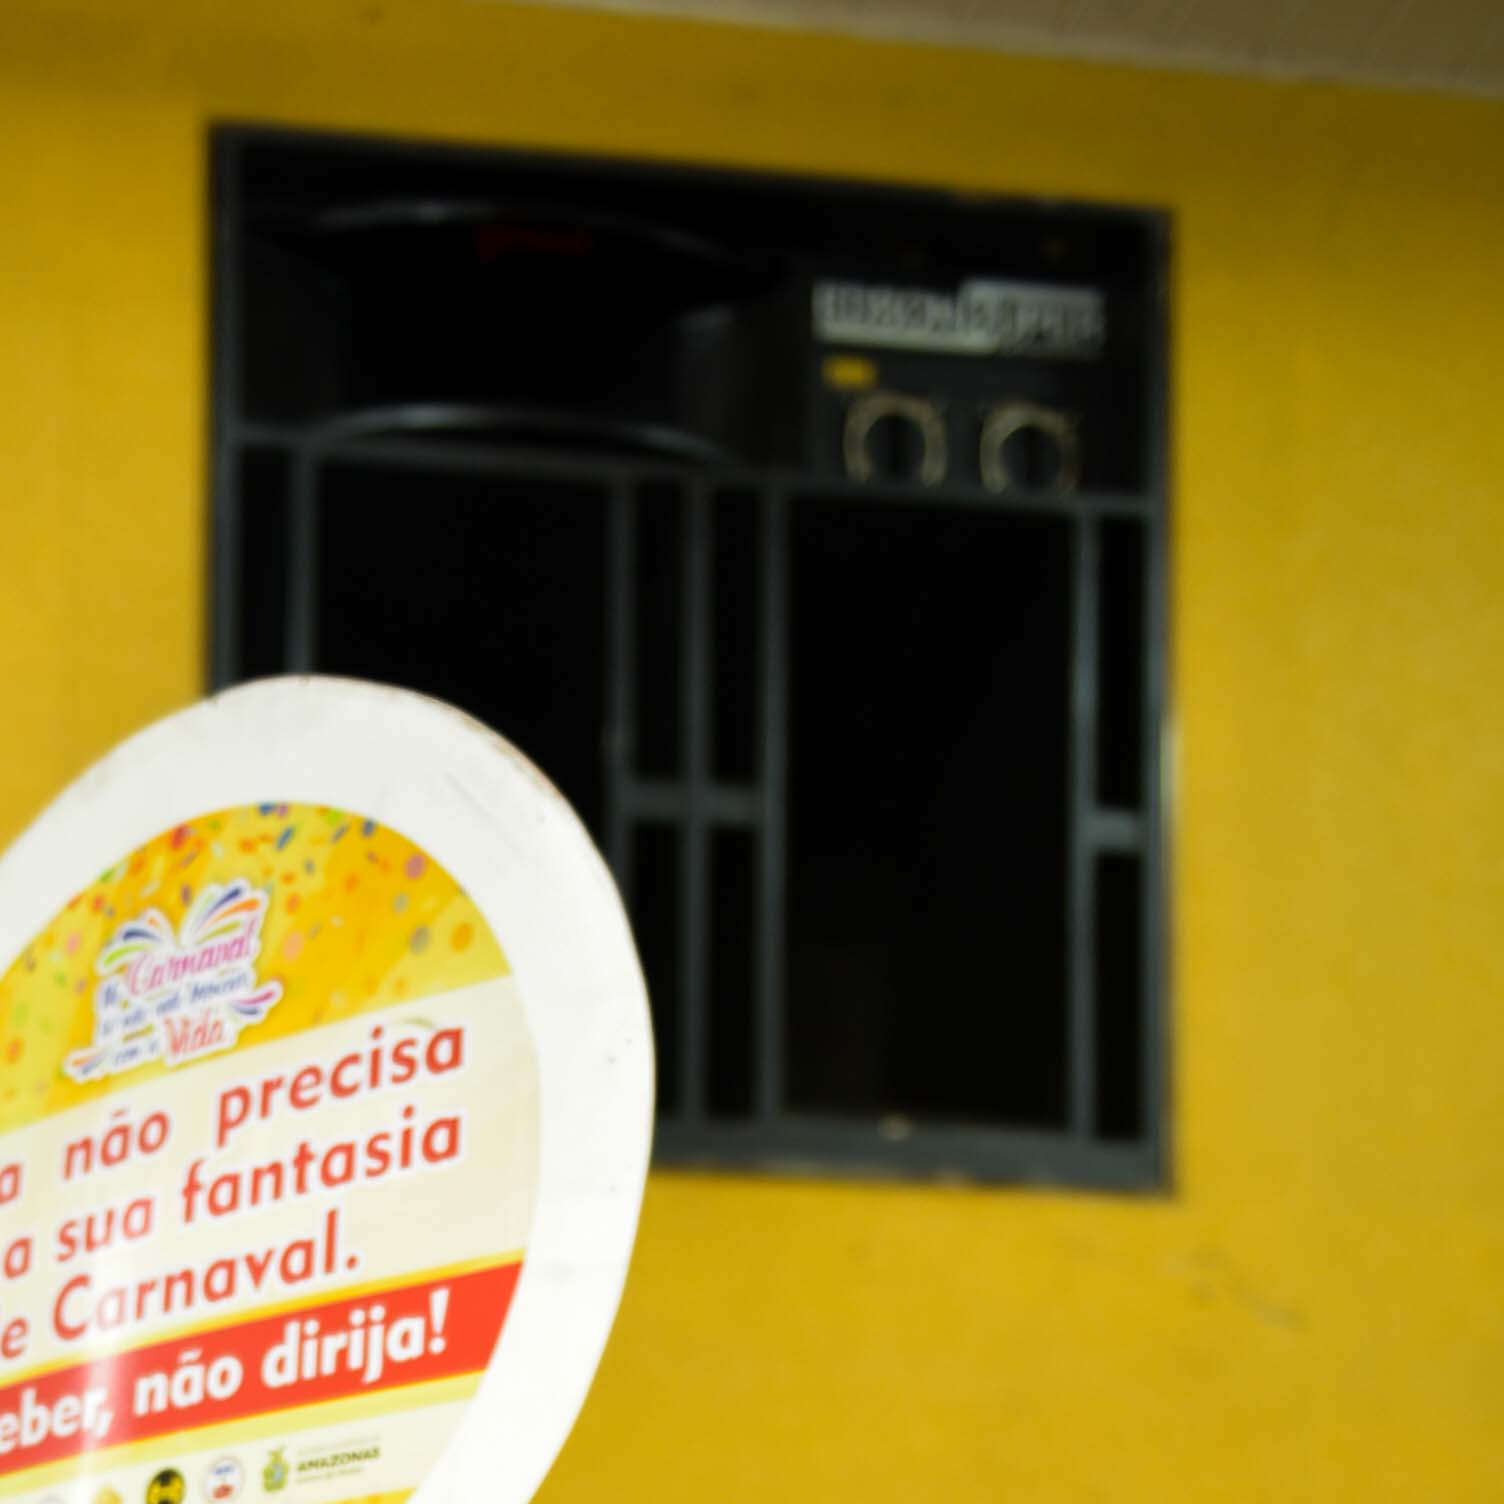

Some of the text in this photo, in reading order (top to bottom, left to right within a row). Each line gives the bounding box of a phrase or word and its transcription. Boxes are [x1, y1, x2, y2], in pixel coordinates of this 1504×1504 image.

[125, 918, 258, 996] Carnaval
[62, 1105, 170, 1178] não
[215, 1026, 465, 1148] precisa
[2, 1236, 33, 1279] a
[55, 1197, 153, 1262] sua
[180, 1104, 462, 1222] fantasia
[51, 1208, 359, 1341] Carnaval.
[133, 1348, 244, 1417] não
[260, 1287, 451, 1388] dirija!
[297, 1445, 381, 1473] AMAZONAS
